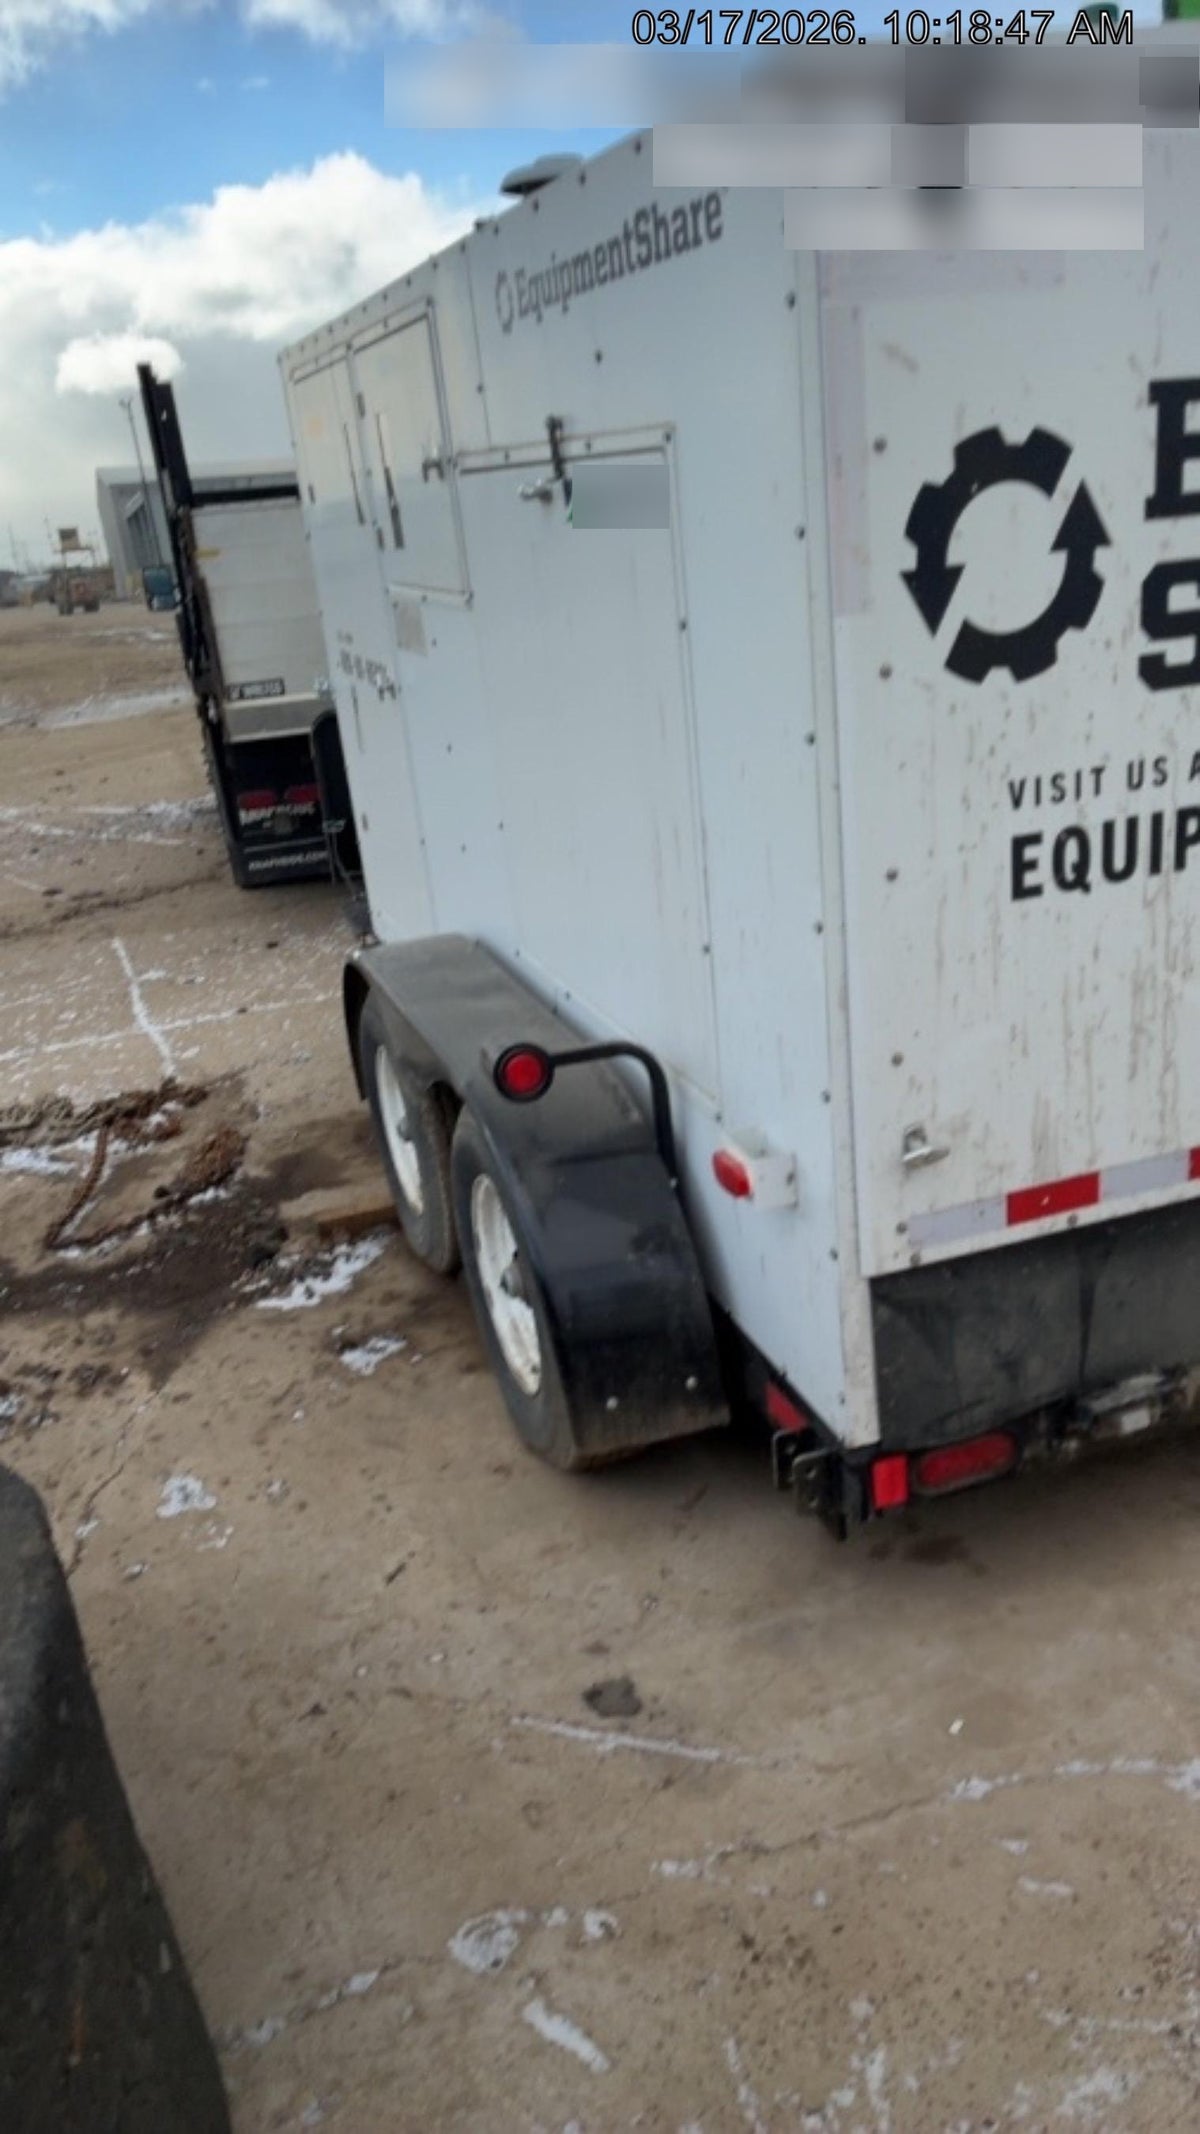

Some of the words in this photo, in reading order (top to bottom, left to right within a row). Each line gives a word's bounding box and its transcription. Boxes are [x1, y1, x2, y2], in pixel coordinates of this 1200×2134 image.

[515, 190, 723, 324] EquipmentShare
[1008, 765, 1106, 811] VISIT
[1127, 756, 1168, 791] US
[1011, 805, 1200, 902] EQUIP
